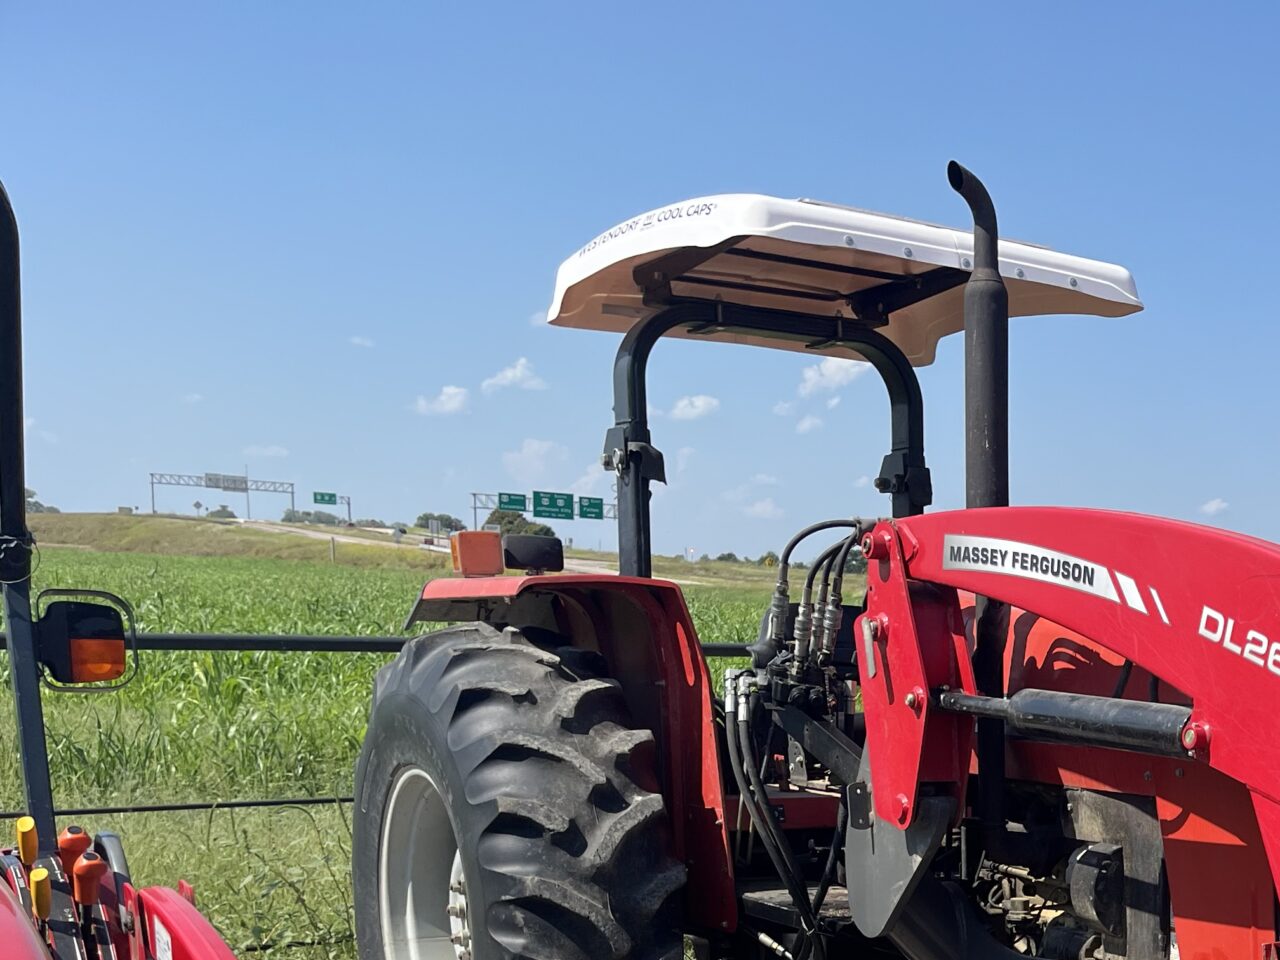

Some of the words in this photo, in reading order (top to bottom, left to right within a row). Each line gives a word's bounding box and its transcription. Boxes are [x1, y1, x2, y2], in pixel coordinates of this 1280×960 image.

[657, 206, 684, 223] COOL
[949, 545, 1009, 568] MASSEY
[1011, 551, 1096, 587] FERGUSON
